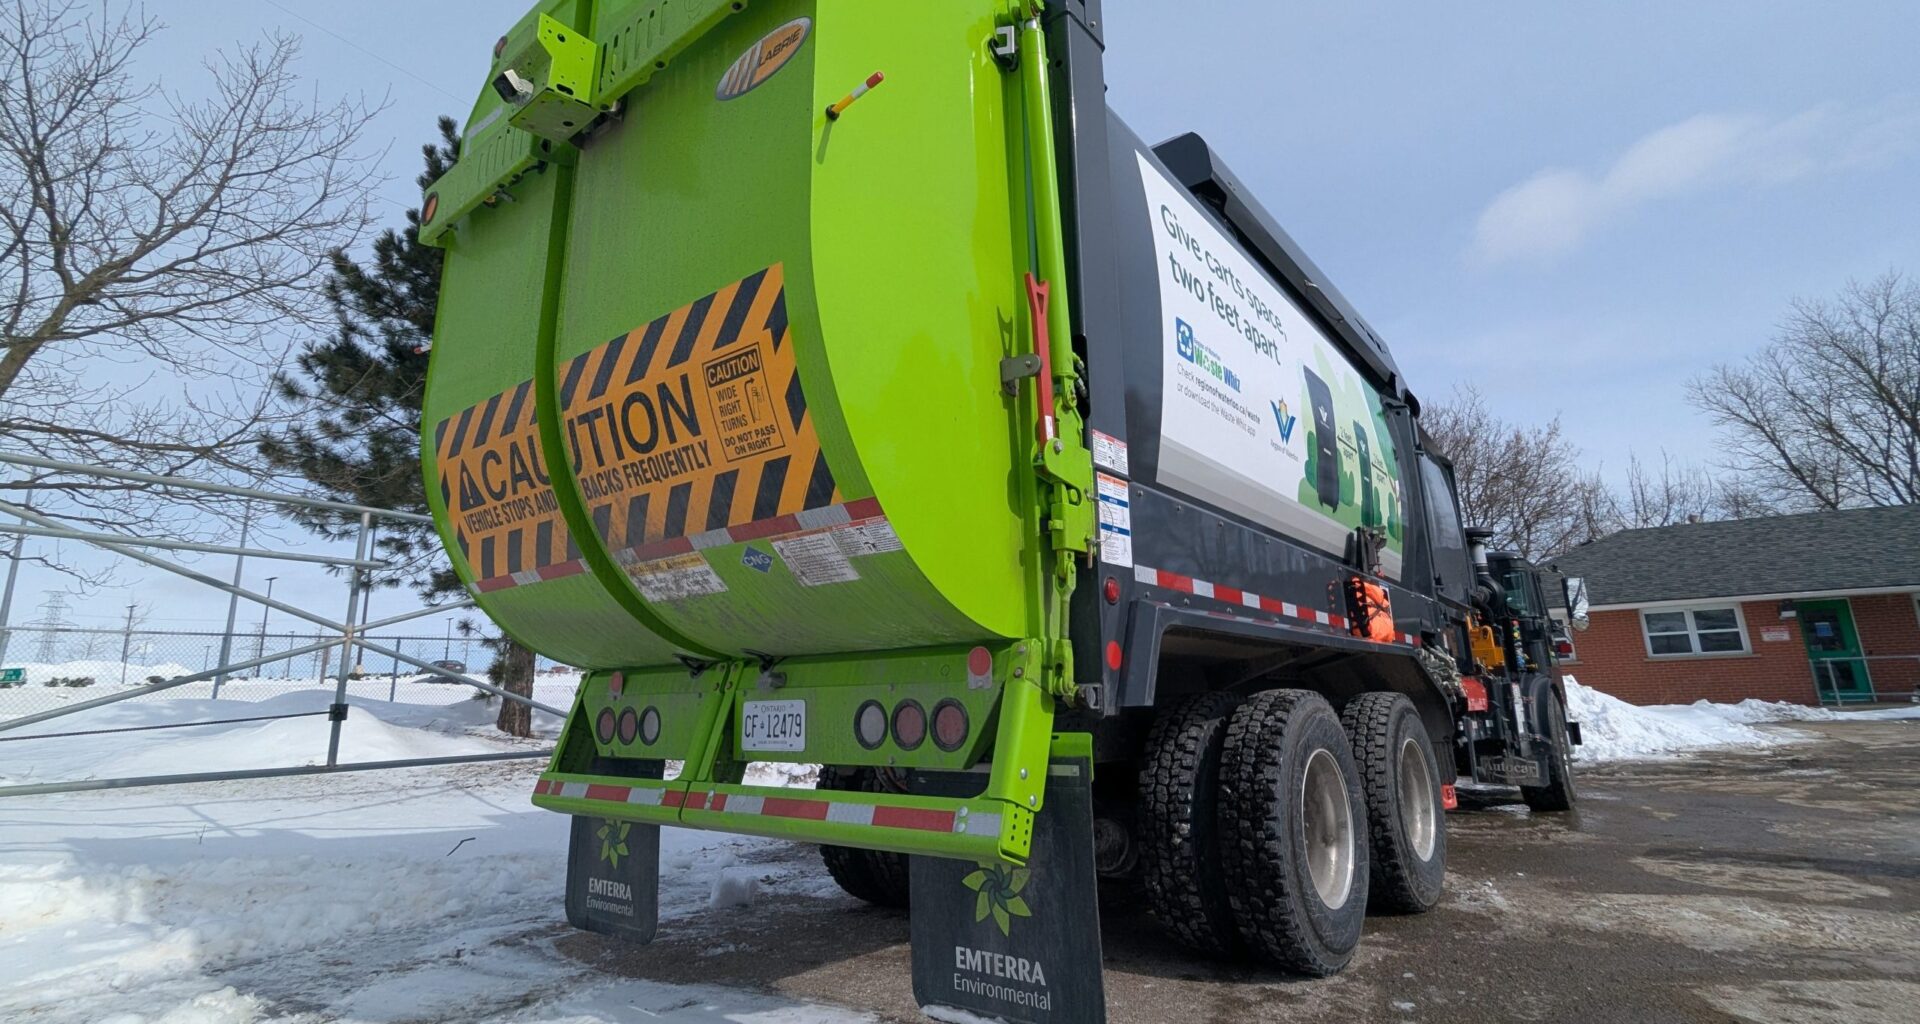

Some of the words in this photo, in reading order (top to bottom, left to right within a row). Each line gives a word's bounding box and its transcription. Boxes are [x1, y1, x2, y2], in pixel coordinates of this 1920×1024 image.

[758, 28, 801, 67] LABRIE
[1161, 204, 1202, 262] Give
[1205, 250, 1244, 299] carts
[1246, 287, 1287, 342] space,
[1169, 251, 1205, 303] two
[1207, 281, 1242, 334] feet
[1244, 319, 1280, 366] apart
[708, 352, 759, 384] CAUTION
[1223, 366, 1241, 393] Whiz
[716, 385, 738, 402] WIDE
[719, 400, 742, 418] RIGHT
[721, 414, 749, 433] TURNS
[724, 436, 736, 448] DO
[737, 431, 753, 443] NOT
[755, 424, 776, 439] PASS
[481, 374, 702, 502] CAUTION
[735, 444, 747, 456] ON
[748, 438, 772, 452] RIGHT
[464, 505, 503, 534] VEHICLE
[503, 496, 536, 524] STOPS
[537, 489, 558, 514] AND
[581, 467, 625, 500] BACKS
[623, 440, 713, 484] FREQUENTLY
[743, 554, 771, 567] CNG
[1486, 760, 1537, 777] Autocar
[588, 877, 632, 901] EMTERRA
[586, 895, 634, 917] Environmental
[955, 946, 1046, 986] EMTERRA
[954, 973, 1050, 1011] Environmental
